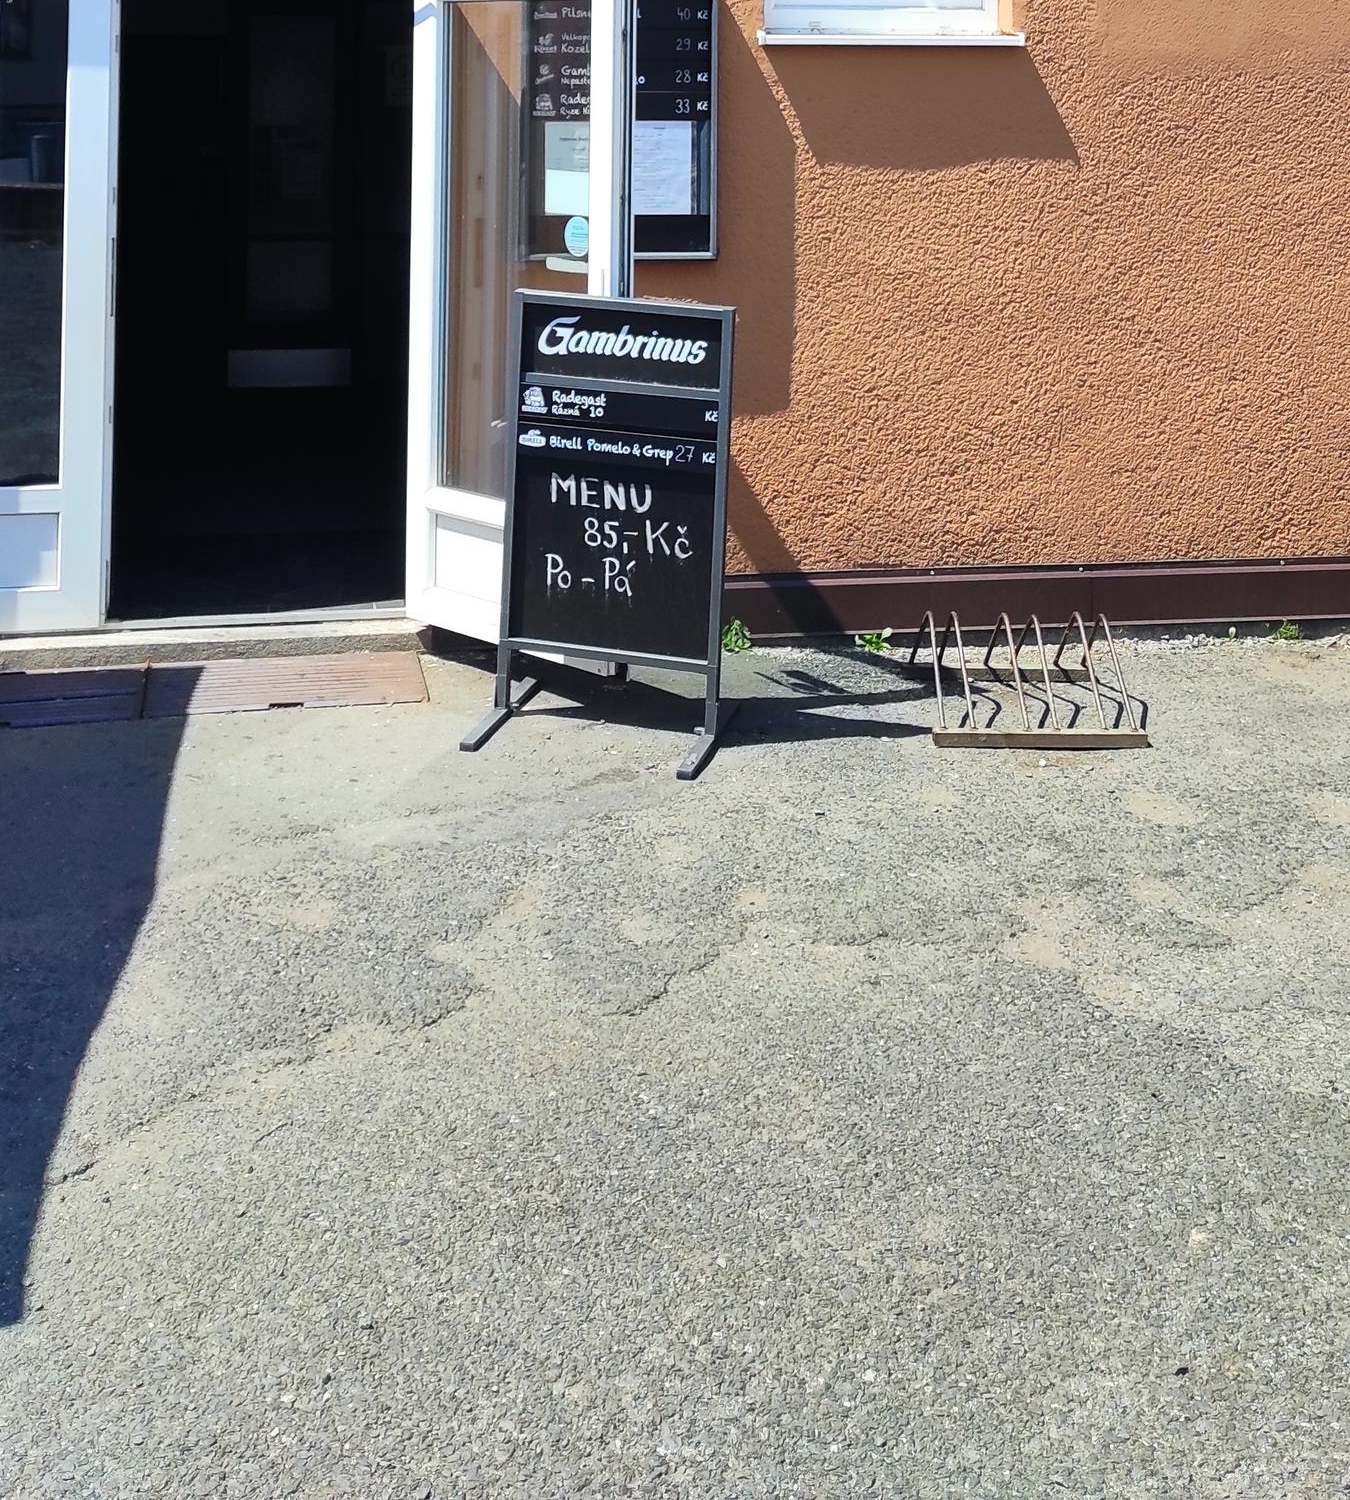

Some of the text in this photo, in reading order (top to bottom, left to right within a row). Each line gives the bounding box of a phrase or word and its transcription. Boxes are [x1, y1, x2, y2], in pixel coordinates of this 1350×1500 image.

[677, 7, 708, 20] 40 Kč
[561, 43, 590, 53] Kozel
[676, 38, 708, 51] 29 Kč
[675, 69, 708, 83] 28 Kč
[675, 99, 708, 113] 33 Kč
[537, 316, 708, 365] Gambrinus
[552, 390, 606, 409] Radegast
[551, 403, 580, 416] Rázná
[589, 406, 604, 417] 10
[704, 411, 718, 422] Kč
[549, 436, 716, 466] Birell Pomelo & Grep 27 Kč
[550, 472, 652, 513] MENU
[645, 519, 693, 559] Kč
[545, 553, 572, 589] Po
[602, 557, 636, 597] Pá
